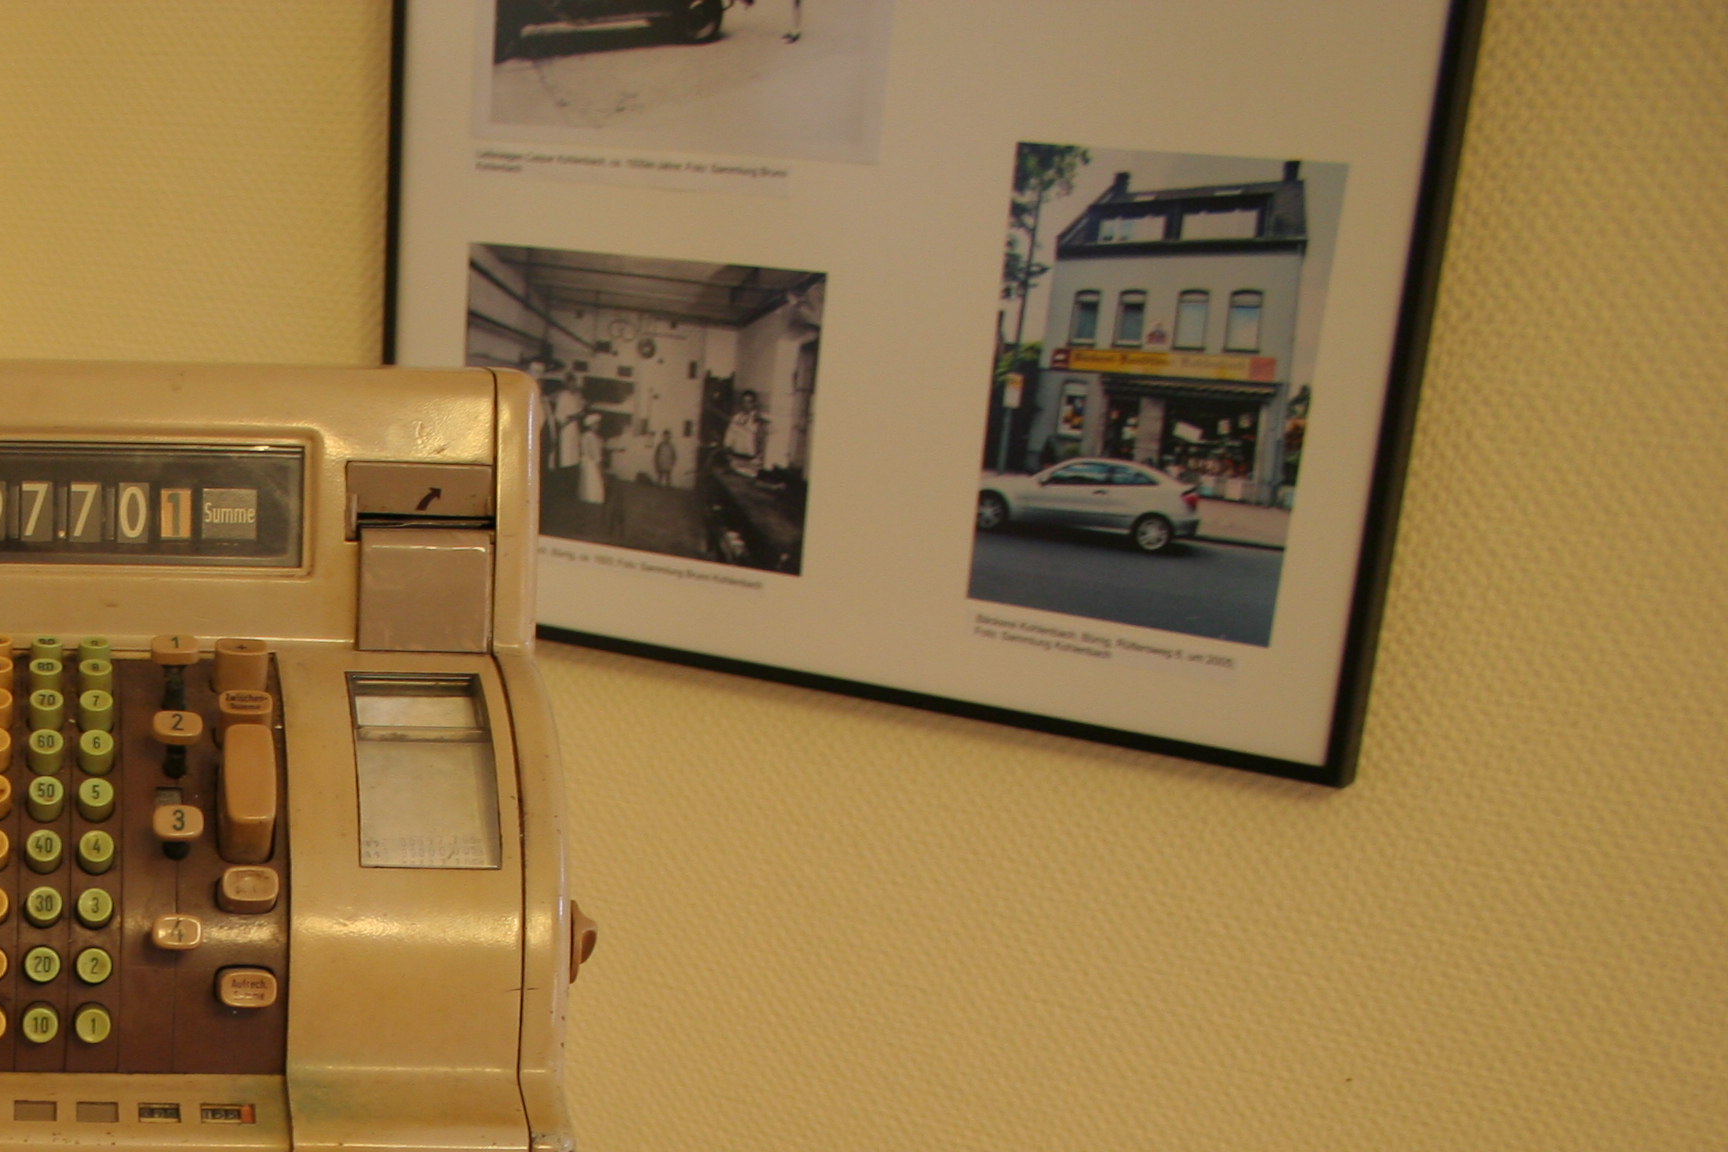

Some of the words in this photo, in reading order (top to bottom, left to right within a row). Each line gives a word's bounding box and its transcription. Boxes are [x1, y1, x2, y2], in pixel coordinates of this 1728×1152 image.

[168, 493, 180, 535] 1
[204, 502, 256, 523] Summe
[171, 637, 179, 649] 1
[38, 694, 55, 706] 70
[172, 714, 184, 731] 2
[38, 735, 54, 748] 60
[92, 736, 101, 749] 6
[38, 783, 55, 798] 50
[92, 785, 100, 799] 5
[173, 810, 185, 831] 3
[35, 838, 53, 854] 40
[93, 839, 100, 853] 4
[36, 895, 53, 912] 30
[91, 897, 99, 913] 3
[34, 956, 51, 973] 20
[90, 957, 99, 975] 2
[33, 1017, 48, 1034] 10
